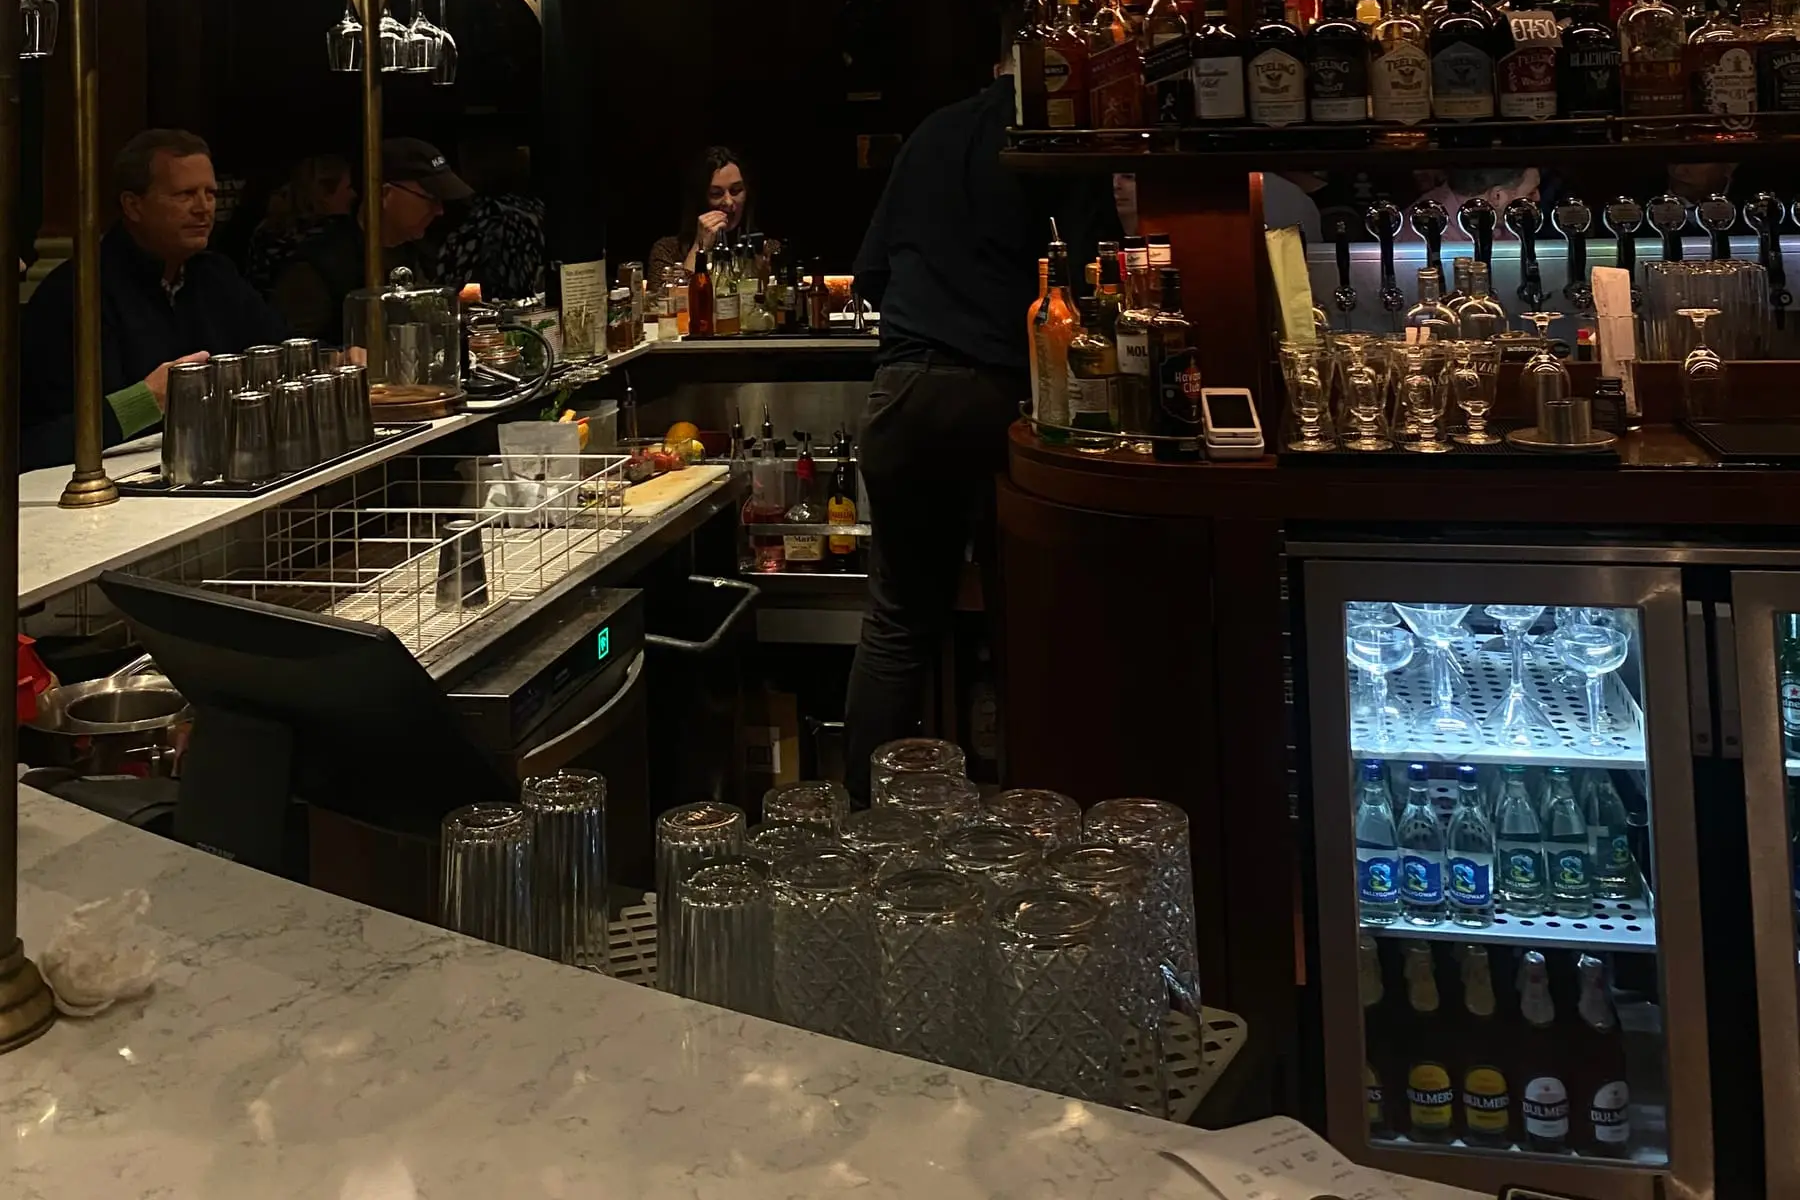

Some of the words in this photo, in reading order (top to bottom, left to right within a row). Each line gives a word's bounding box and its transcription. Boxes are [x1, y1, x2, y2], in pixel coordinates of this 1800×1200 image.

[1254, 63, 1297, 77] TEELING
[1310, 60, 1351, 74] TEELING
[1384, 59, 1427, 73] TEELING
